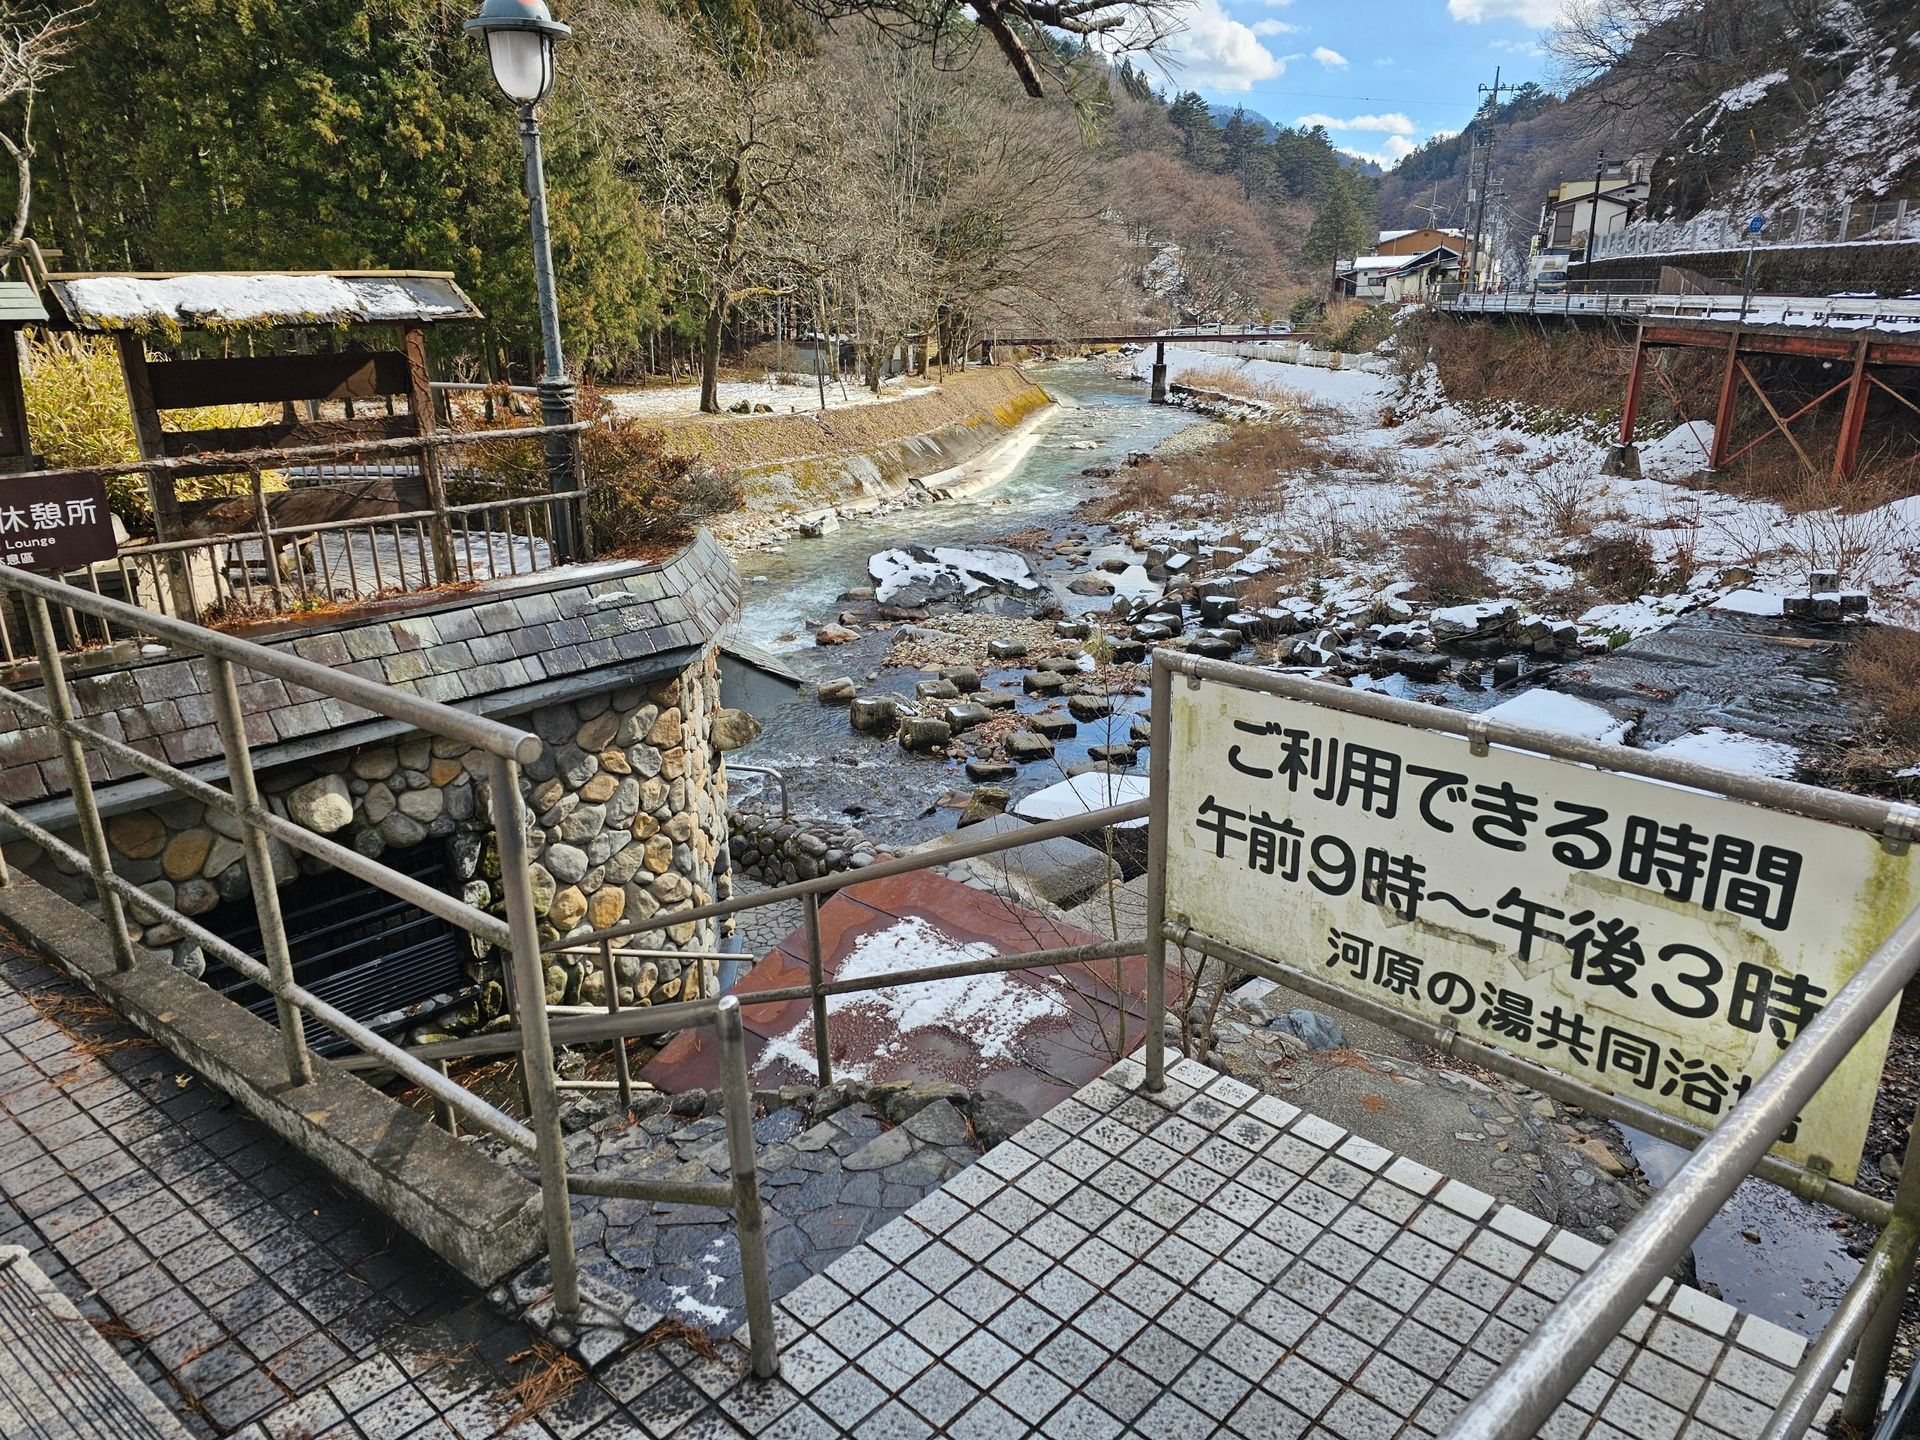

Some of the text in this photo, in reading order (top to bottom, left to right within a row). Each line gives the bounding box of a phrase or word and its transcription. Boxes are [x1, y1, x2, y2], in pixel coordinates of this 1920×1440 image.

[0, 498, 97, 534] 休憩所
[5, 537, 56, 550] Lounge
[1228, 719, 1803, 931] ご利用できる時間
